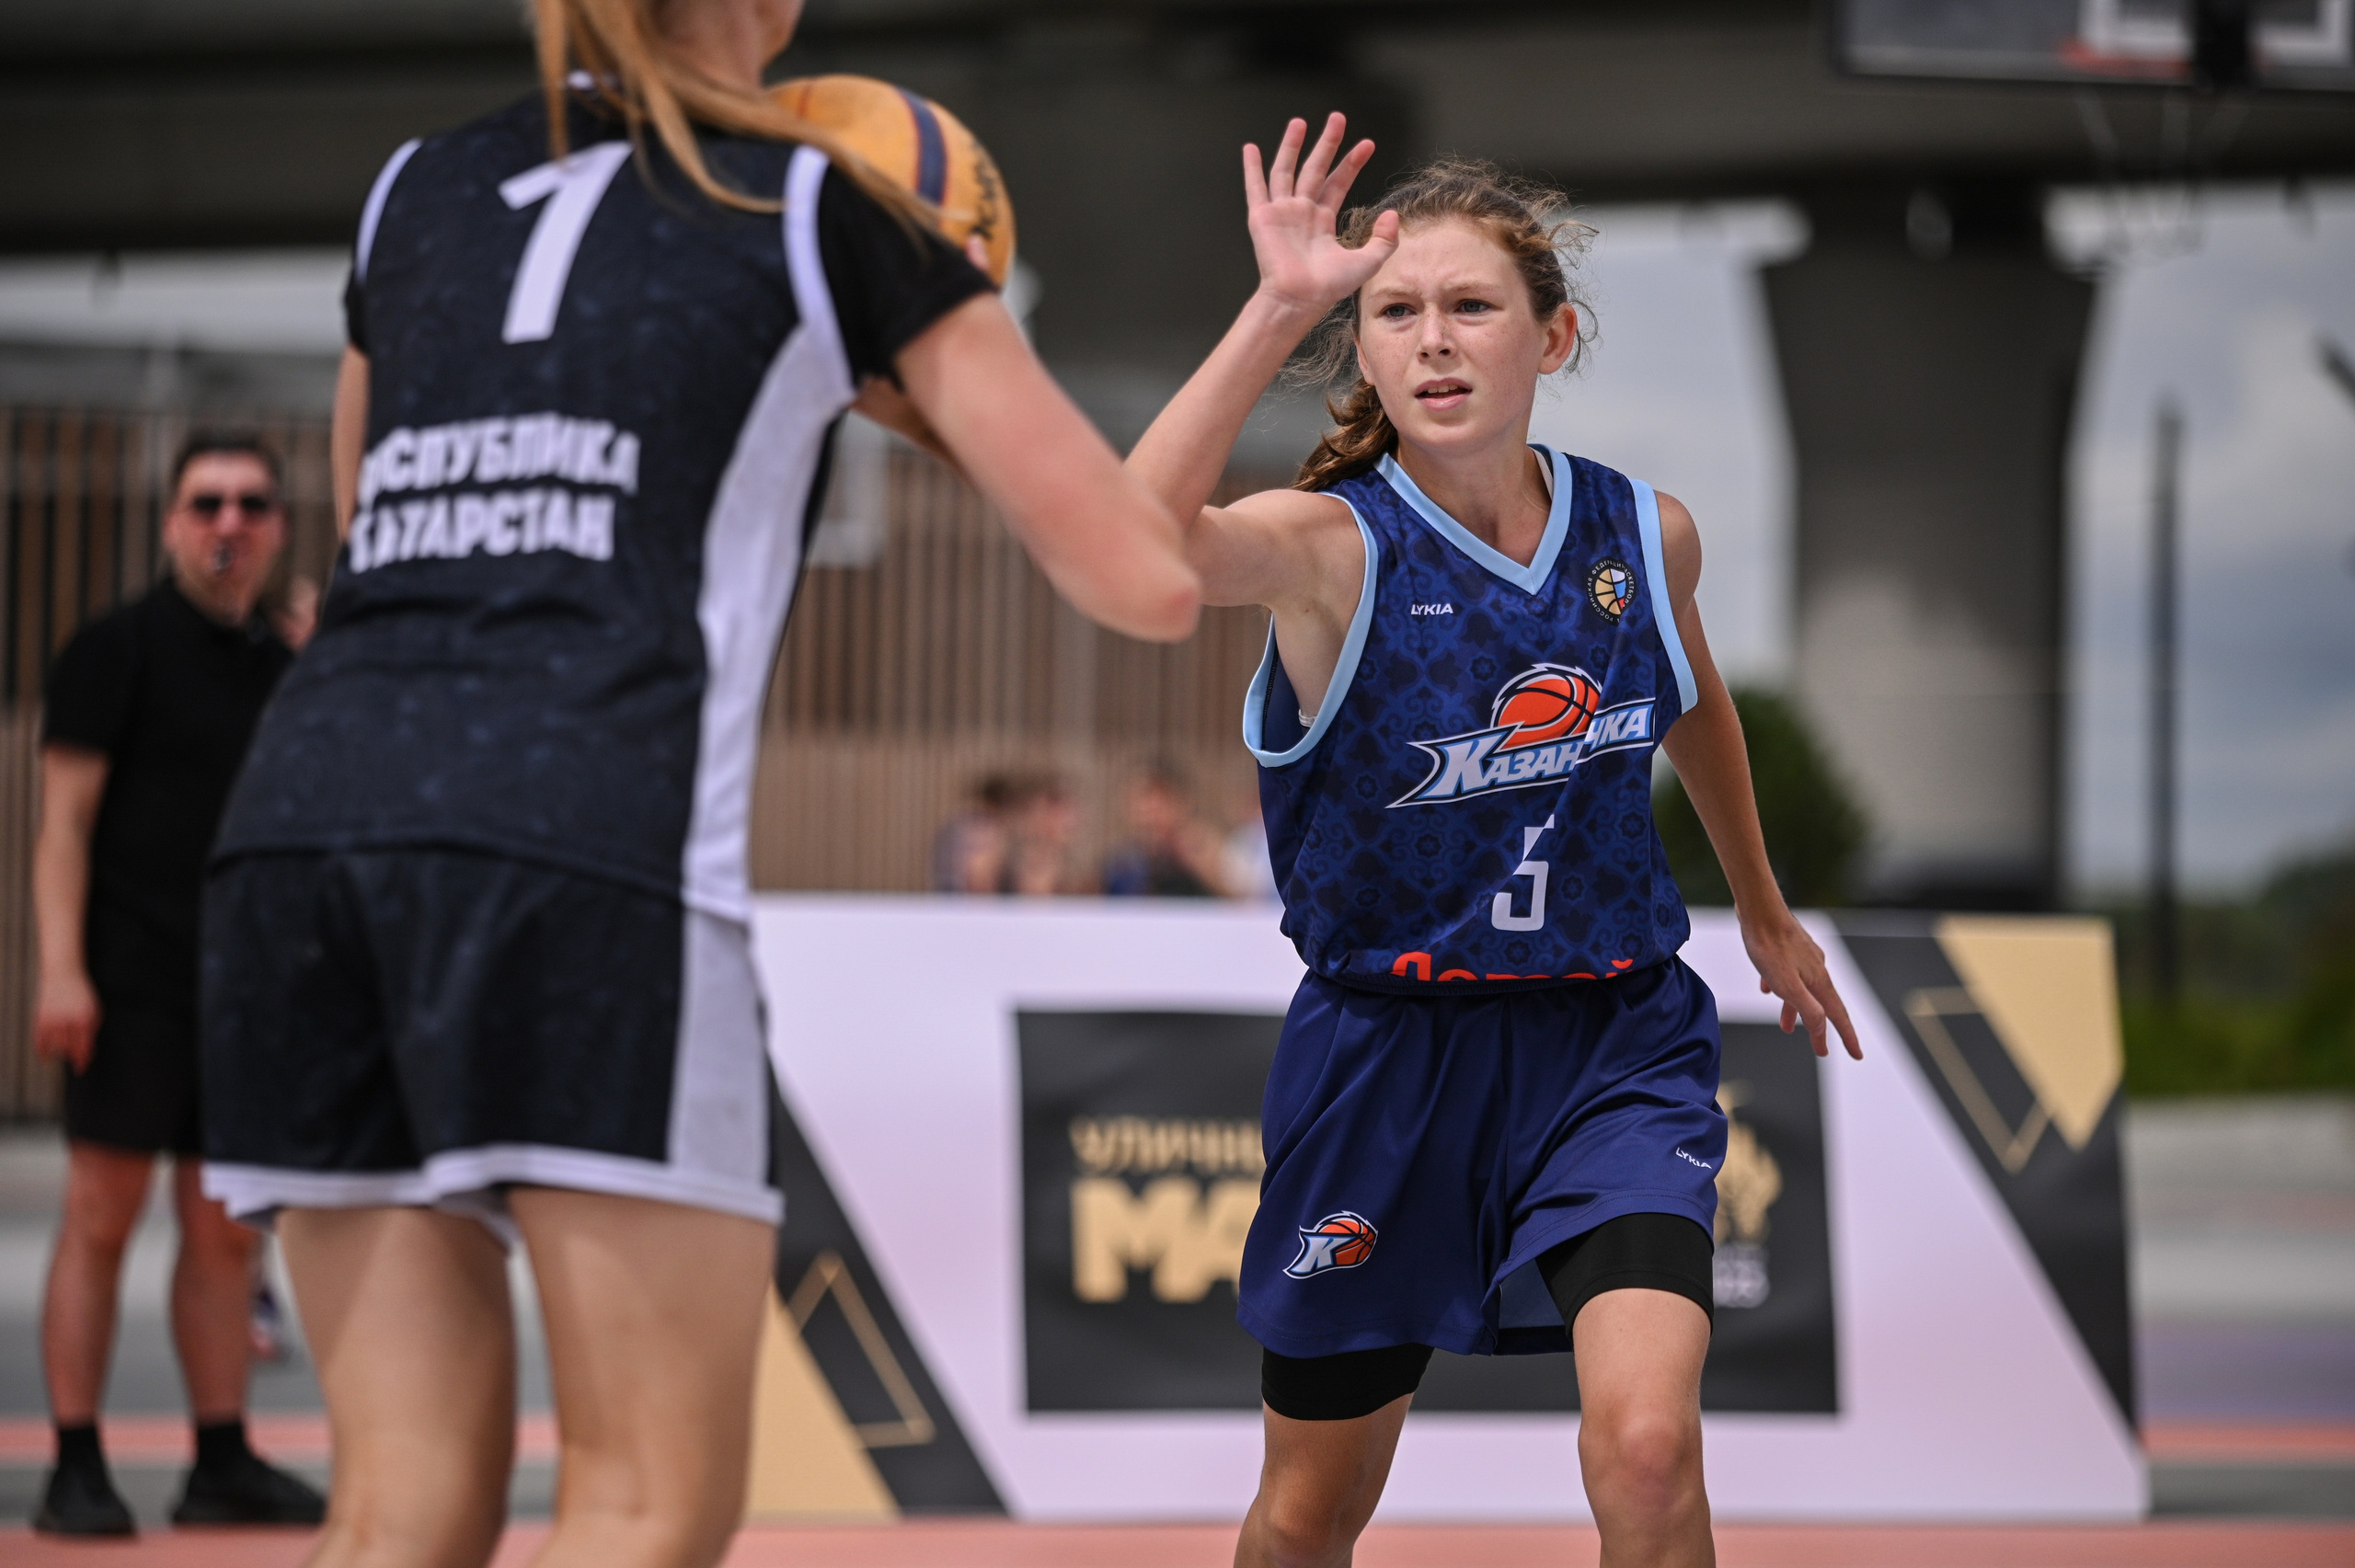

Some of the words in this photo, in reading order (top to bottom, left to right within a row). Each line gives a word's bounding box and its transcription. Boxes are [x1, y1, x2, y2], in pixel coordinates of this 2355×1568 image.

[498, 141, 635, 345] 1
[1410, 603, 1454, 616] LYKIA
[1422, 706, 1649, 797] КАЗАНЧКА
[1491, 813, 1555, 932] 5
[1675, 1147, 1713, 1170] LYKIA
